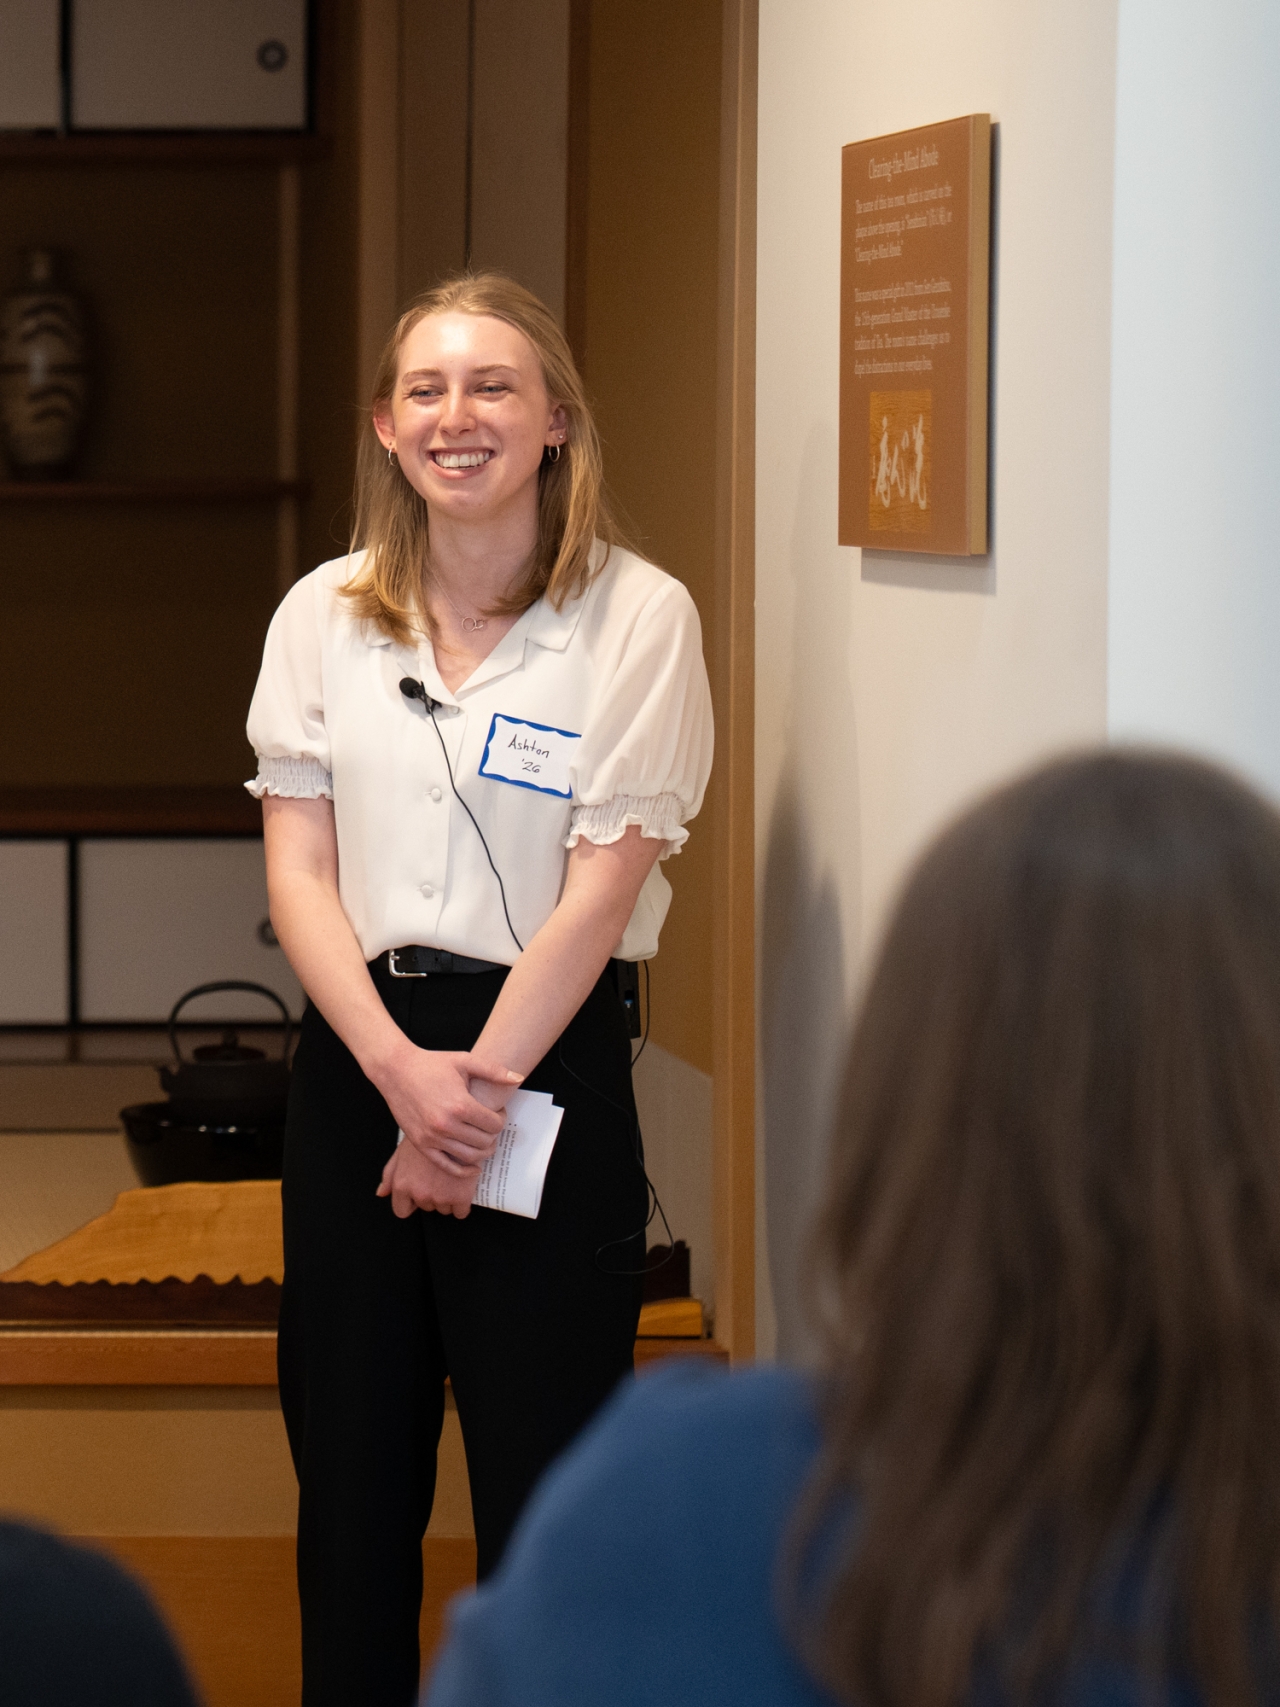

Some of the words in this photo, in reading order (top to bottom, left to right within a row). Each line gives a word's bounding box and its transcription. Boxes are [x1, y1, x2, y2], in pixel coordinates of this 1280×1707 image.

[869, 147, 919, 181] Clearing-the-Mind
[919, 145, 938, 169] Abode
[507, 733, 550, 759] Ashton
[521, 758, 542, 774] '26
